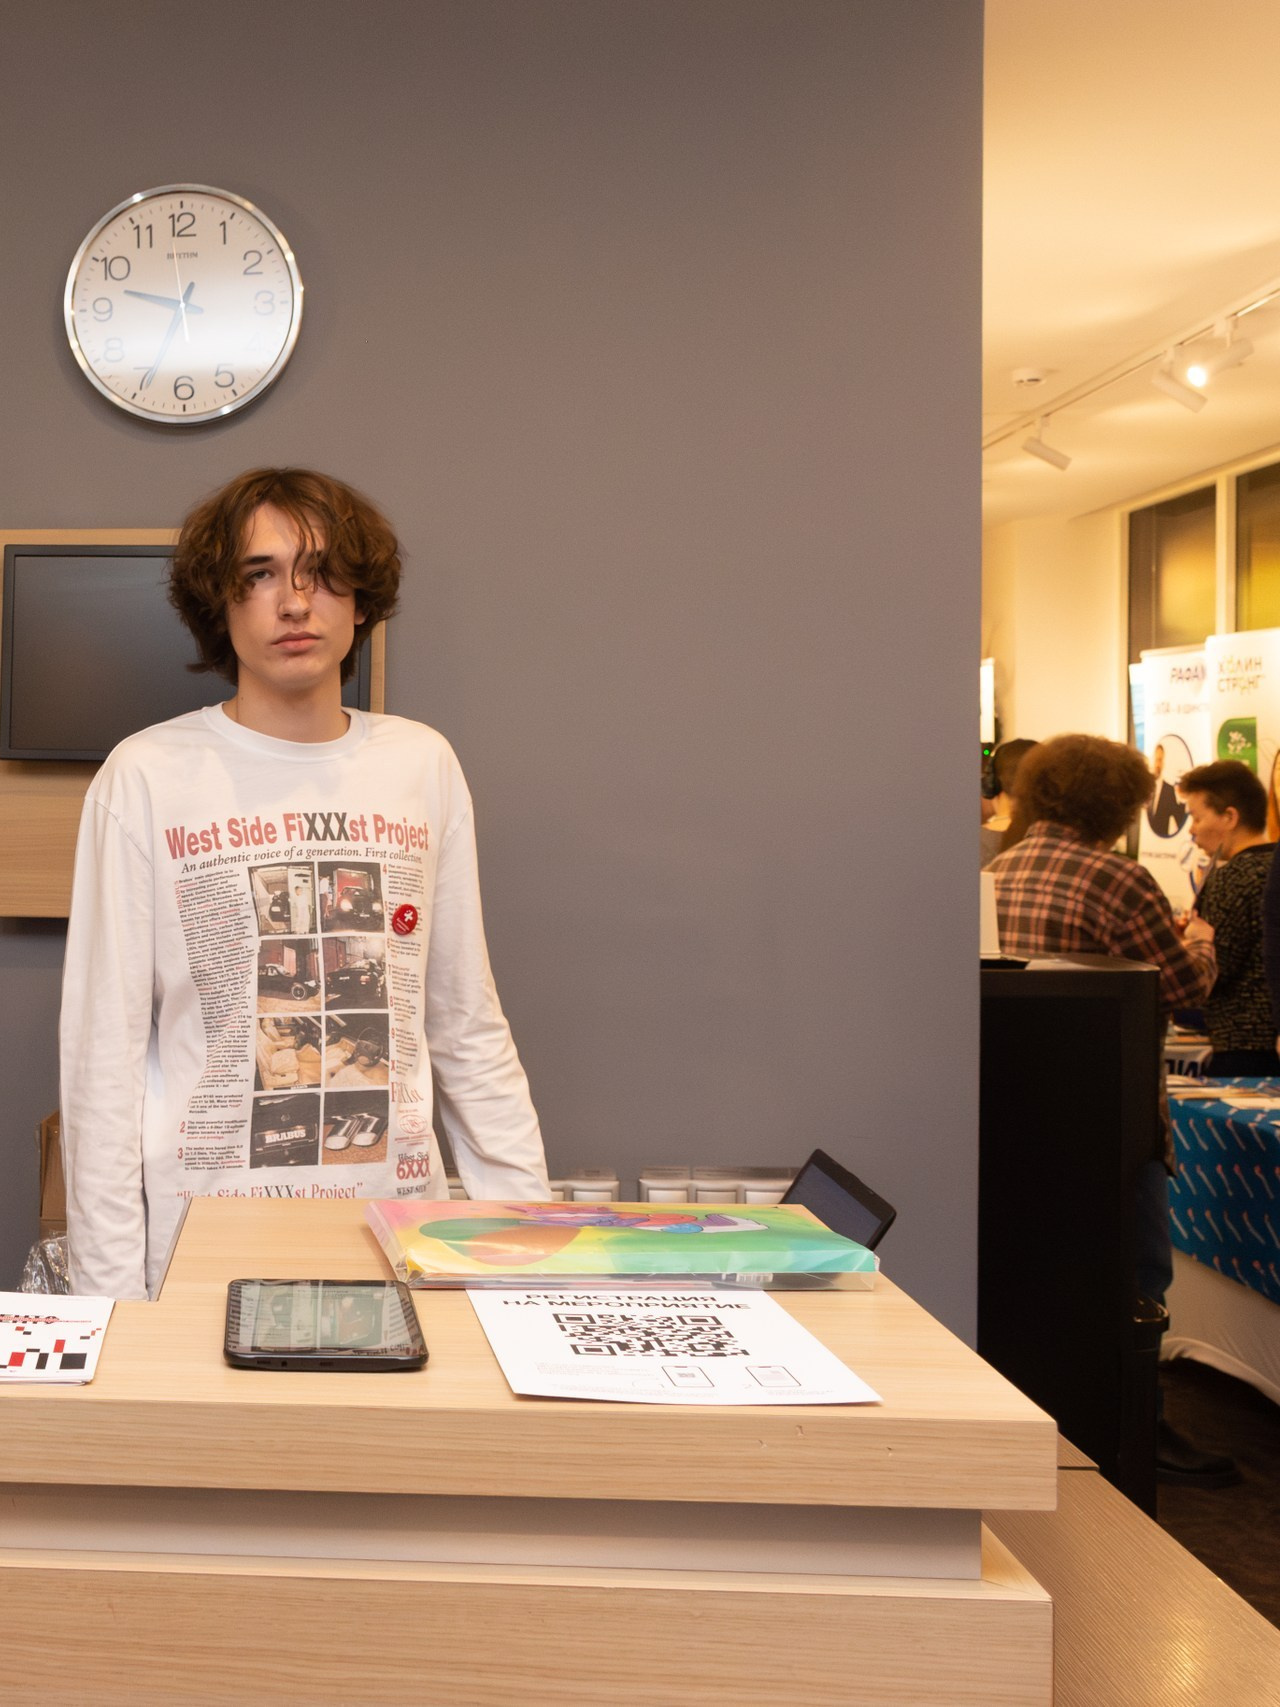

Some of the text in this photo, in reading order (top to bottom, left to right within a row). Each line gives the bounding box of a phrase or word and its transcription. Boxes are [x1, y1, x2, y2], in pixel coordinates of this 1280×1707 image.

[133, 224, 153, 248] 11
[168, 212, 196, 237] 12
[219, 220, 226, 245] 1
[101, 256, 131, 281] 10
[243, 250, 263, 275] 2
[93, 297, 113, 322] 9
[254, 290, 275, 316] 3
[103, 338, 125, 363] 8
[133, 367, 153, 391] 7
[214, 363, 235, 388] 5
[173, 376, 195, 401] 6
[165, 813, 428, 860] West Side FiXXXst Project
[181, 863, 197, 874] An
[200, 852, 251, 870] authentic
[254, 848, 280, 860] voice
[284, 846, 296, 859] of
[297, 849, 302, 857] a
[306, 847, 361, 859] generation.
[365, 848, 387, 859] First
[526, 1294, 717, 1302] РЕГИСТРАЦИЯ
[548, 1301, 751, 1310] МЕРОПРИЯТИЕ
